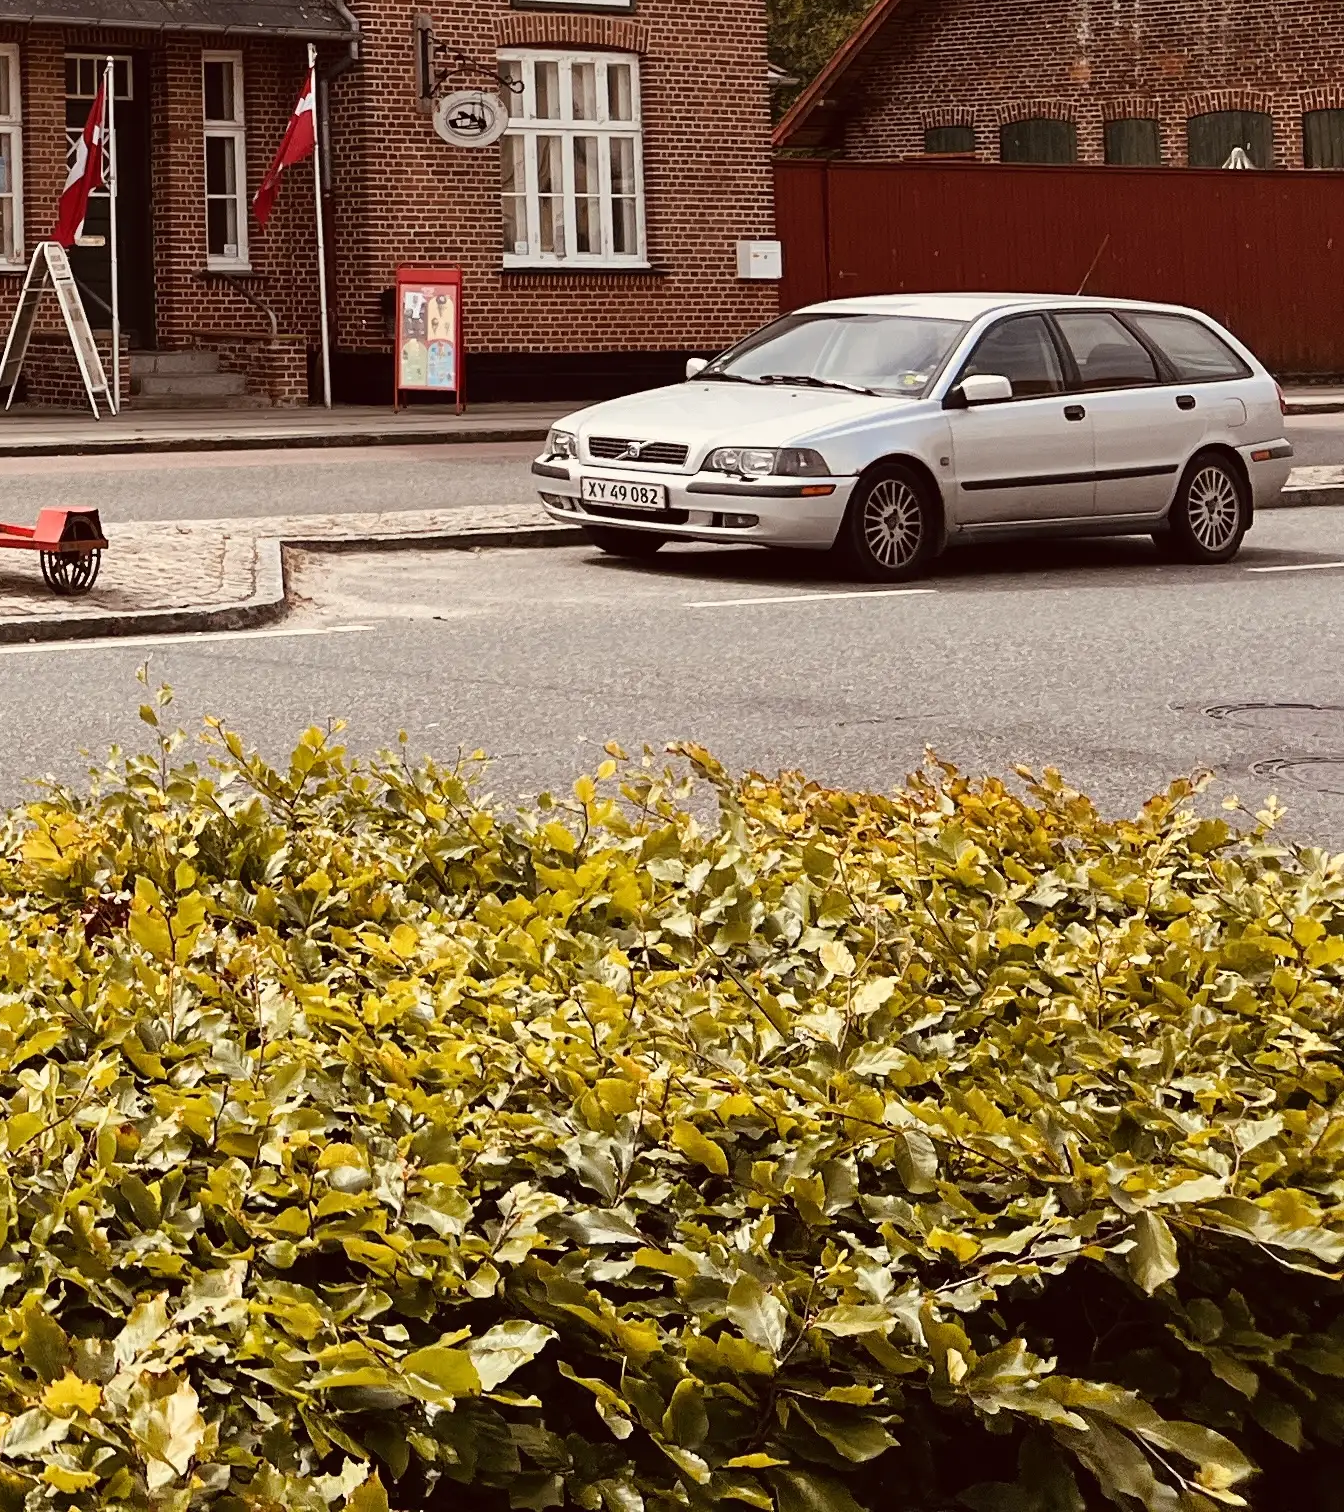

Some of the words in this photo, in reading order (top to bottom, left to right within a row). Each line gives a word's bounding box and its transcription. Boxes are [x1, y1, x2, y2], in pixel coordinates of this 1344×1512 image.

[588, 481, 606, 498] XY
[610, 484, 627, 501] 49
[631, 486, 658, 504] 082
